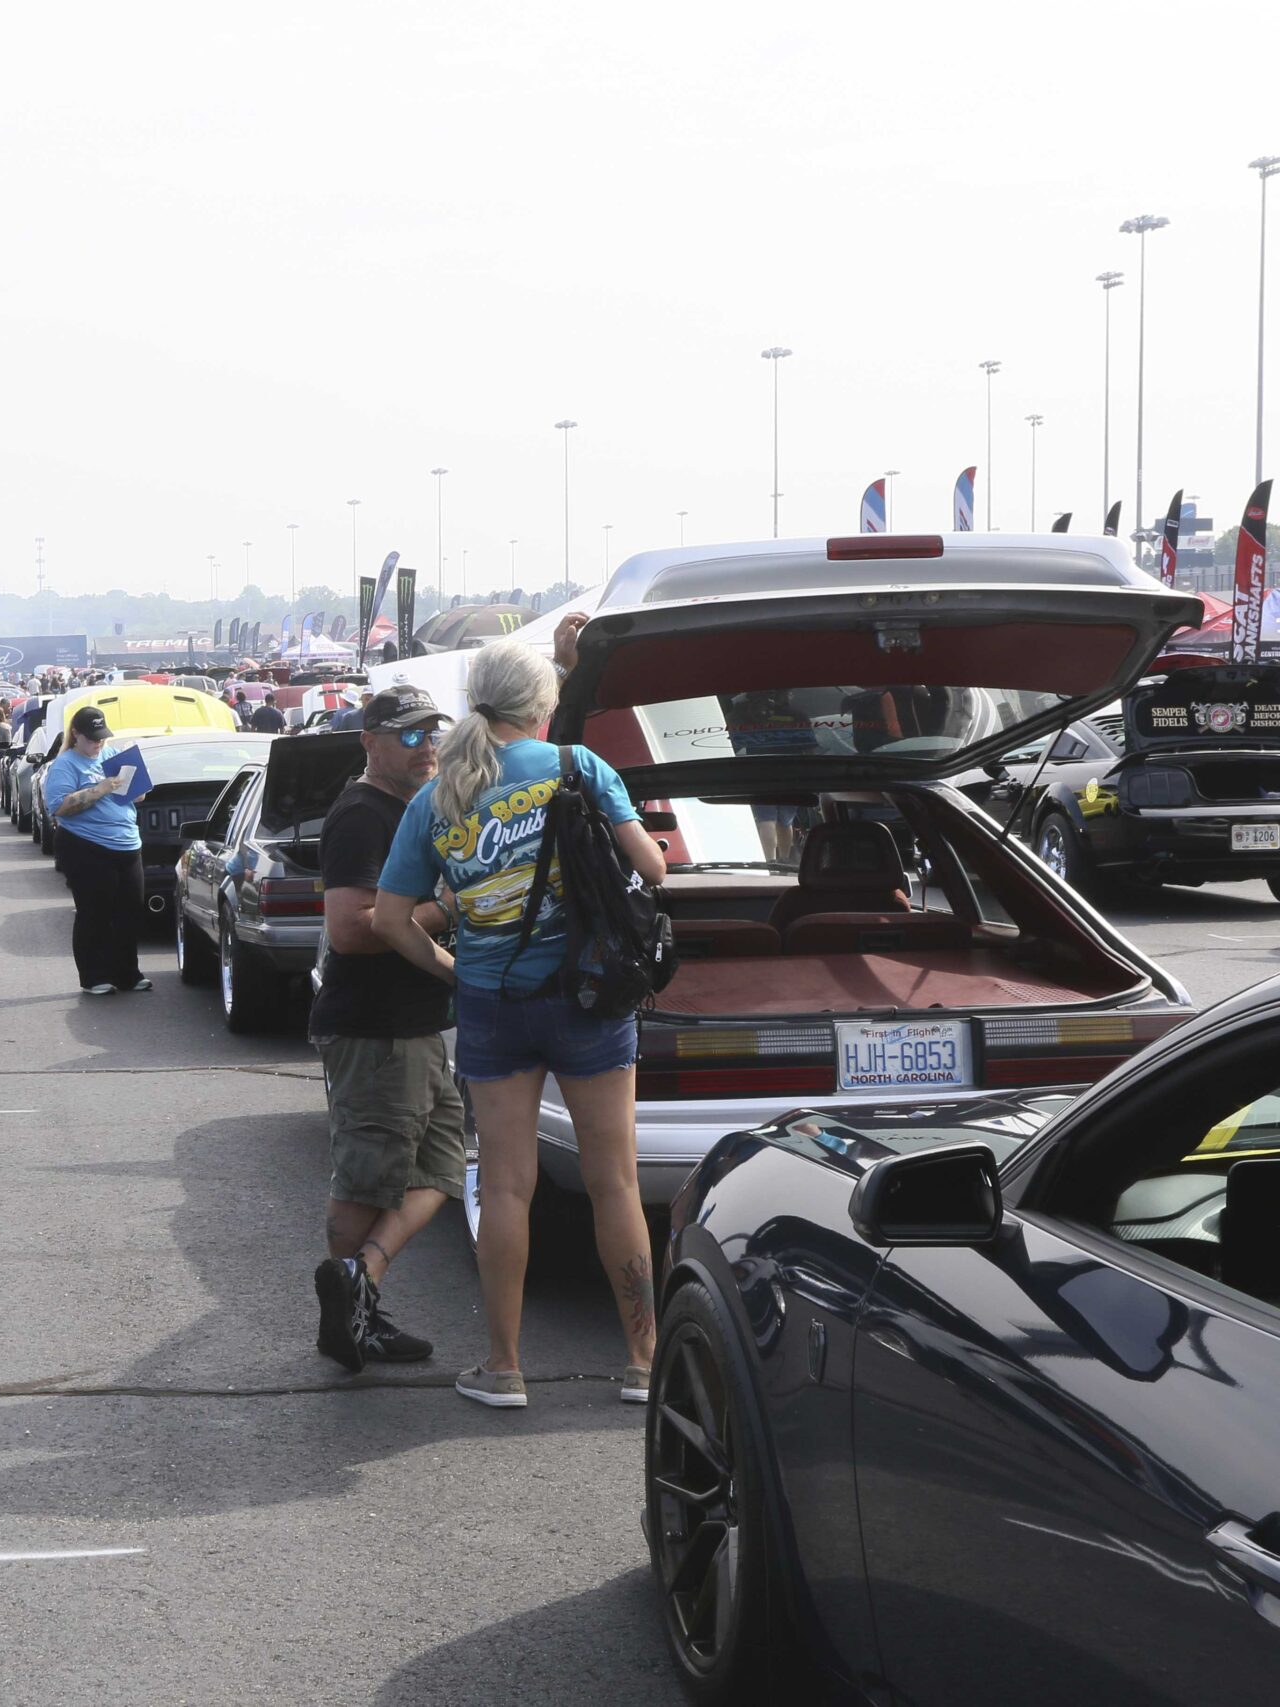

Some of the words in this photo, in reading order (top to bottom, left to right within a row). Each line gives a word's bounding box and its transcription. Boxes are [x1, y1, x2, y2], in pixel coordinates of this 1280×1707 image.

[1245, 554, 1263, 664] ANKSHAFTS
[1233, 583, 1249, 663] SCAT
[1151, 708, 1188, 717] SEMPER
[1152, 717, 1189, 727] FIDELIS
[434, 812, 482, 861] FOX
[489, 777, 561, 824] BODY
[476, 808, 548, 865] Cruis
[1253, 831, 1275, 842] 1206
[865, 1029, 888, 1038] First
[892, 1029, 902, 1037] in
[907, 1027, 935, 1039] Flight
[844, 1040, 957, 1073] HJH-6853
[851, 1074, 892, 1084] NORTH
[896, 1072, 955, 1083] CAROLINA
